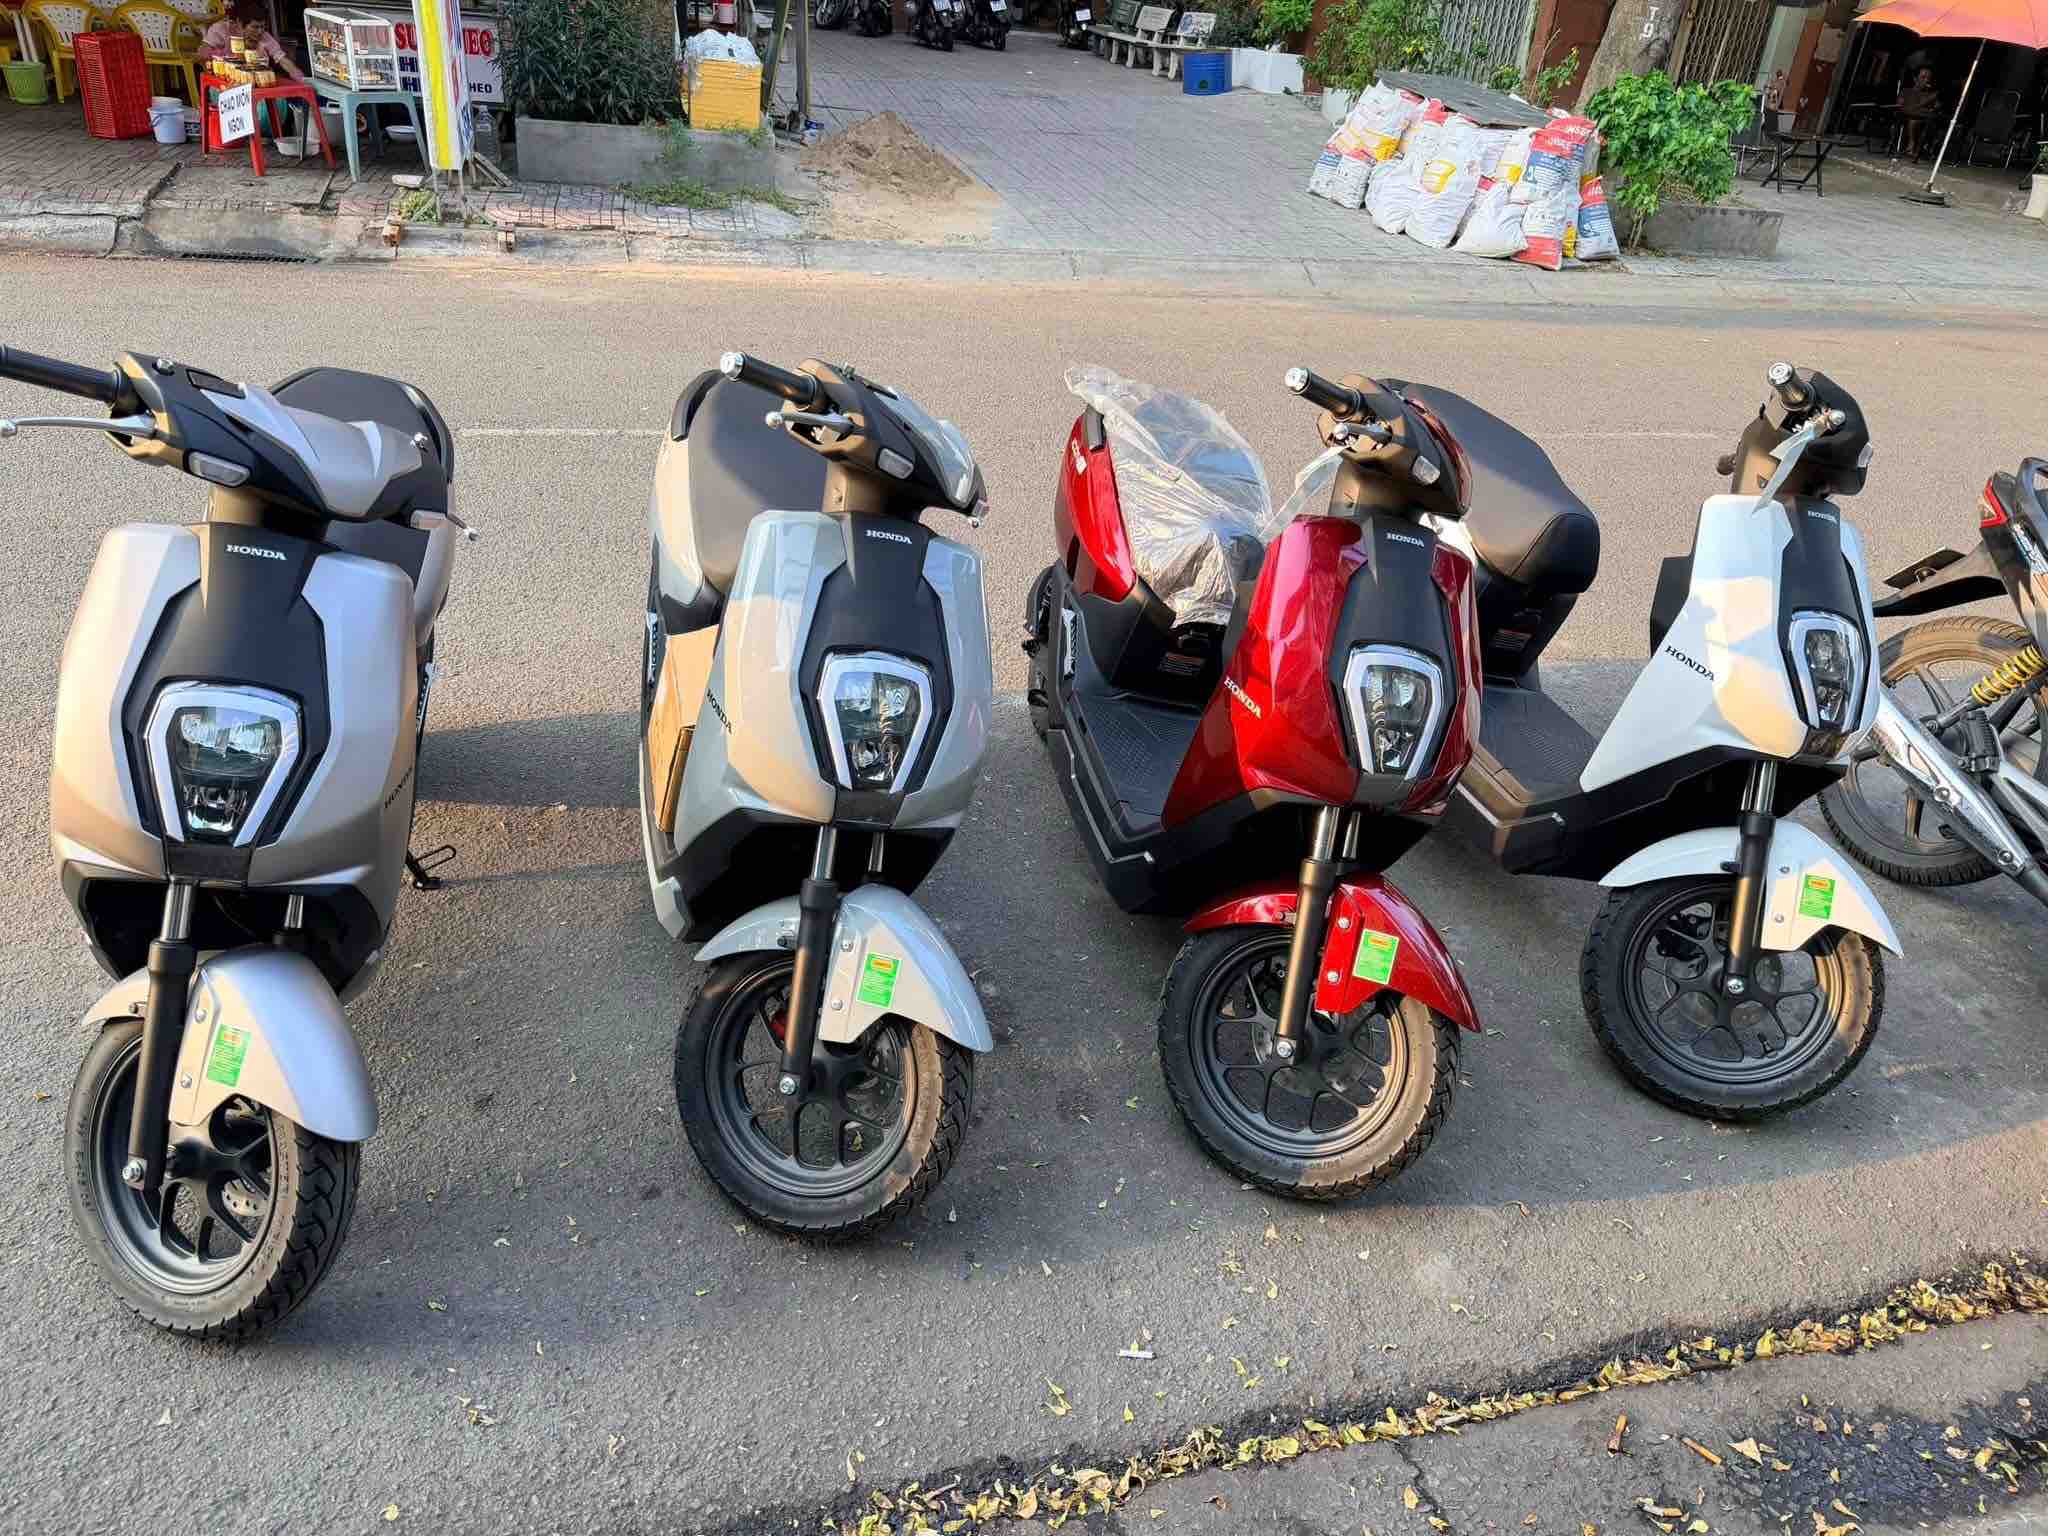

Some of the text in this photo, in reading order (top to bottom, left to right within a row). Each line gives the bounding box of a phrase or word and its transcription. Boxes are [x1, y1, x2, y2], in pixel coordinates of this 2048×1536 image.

[865, 529, 913, 545] HONDA
[1386, 532, 1425, 548] HONDA
[224, 544, 288, 561] HONDA
[1664, 645, 1715, 682] HONDA
[1223, 676, 1262, 719] HONDA
[705, 688, 733, 735] HONDA
